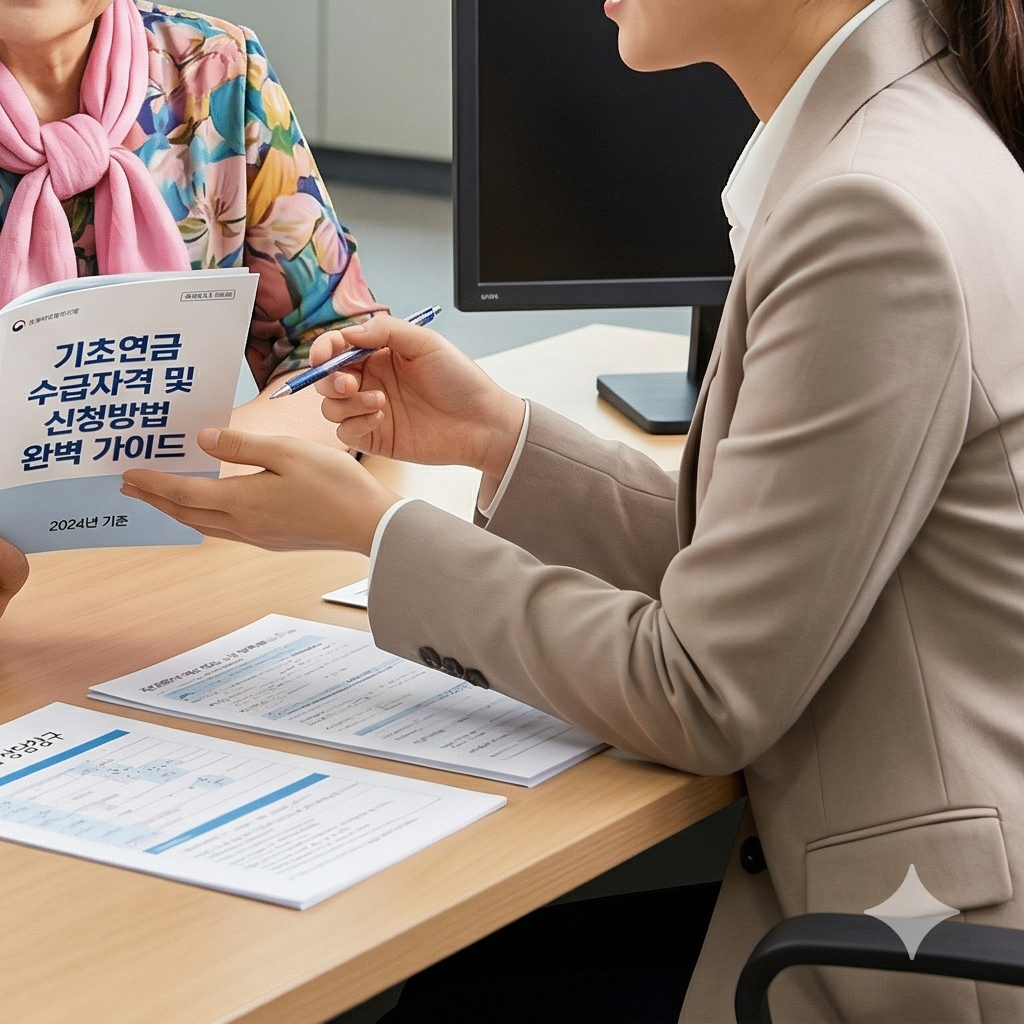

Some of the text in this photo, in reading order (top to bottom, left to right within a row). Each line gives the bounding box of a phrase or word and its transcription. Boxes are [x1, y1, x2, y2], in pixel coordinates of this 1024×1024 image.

[54, 333, 182, 368] 기초연금
[27, 366, 195, 405] 수급자격 및
[44, 401, 170, 437] 신청방법
[21, 433, 186, 471] 완벽 가이드
[49, 516, 98, 532] 2024년
